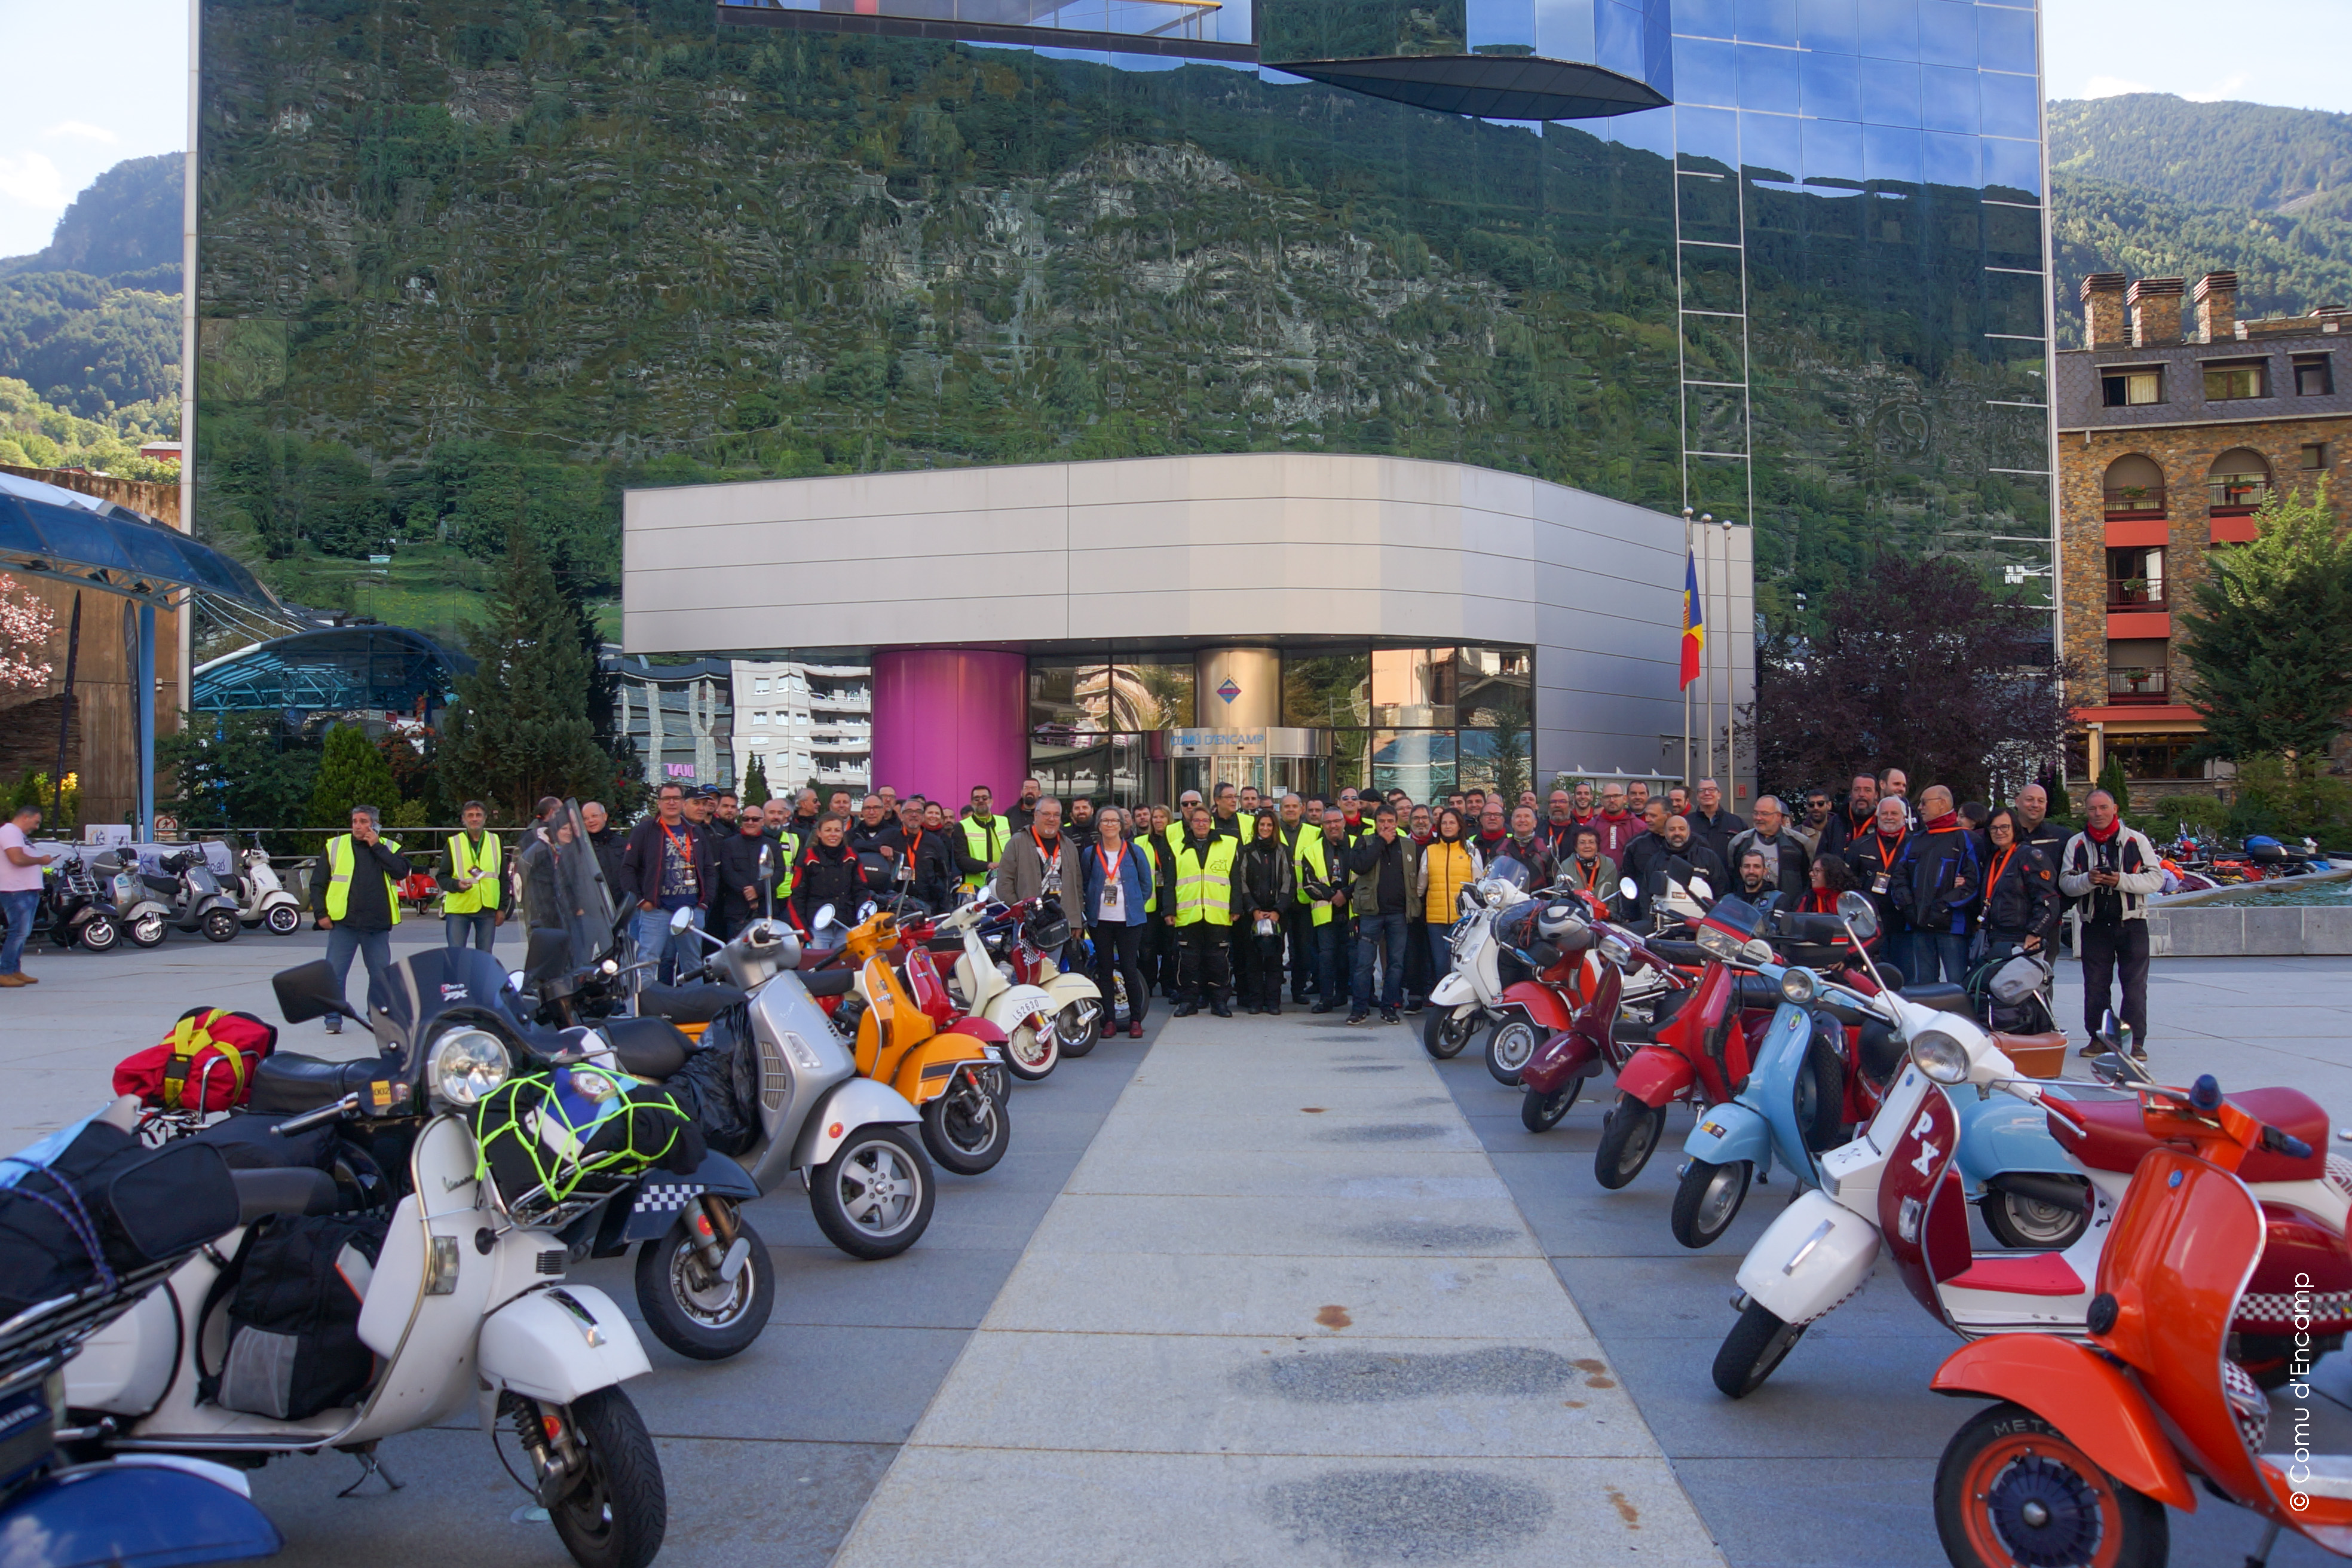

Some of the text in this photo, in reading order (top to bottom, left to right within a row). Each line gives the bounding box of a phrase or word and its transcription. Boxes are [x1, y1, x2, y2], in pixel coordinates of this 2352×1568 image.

[1171, 733, 1264, 746] COMÚ D'ENCAMP
[373, 1087, 390, 1096] 002
[1910, 1110, 1940, 1177] PX
